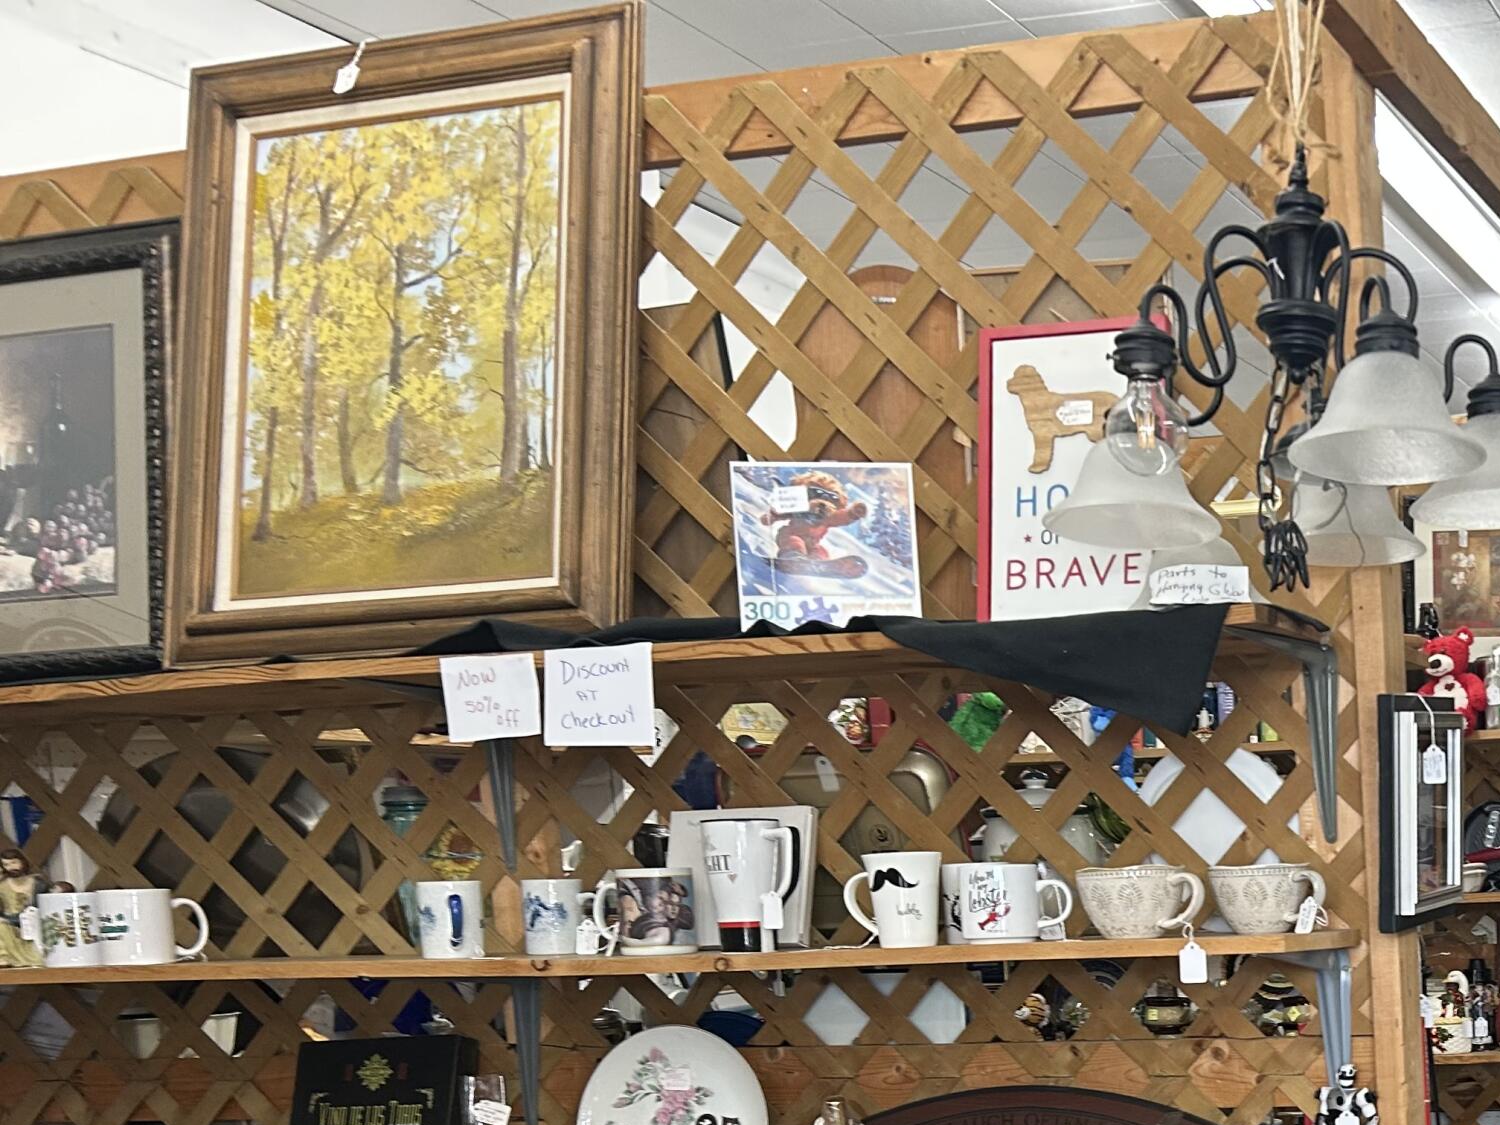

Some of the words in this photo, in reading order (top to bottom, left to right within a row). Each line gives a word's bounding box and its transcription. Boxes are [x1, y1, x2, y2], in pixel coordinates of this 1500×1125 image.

[1016, 484, 1069, 517] HO
[1006, 553, 1142, 591] BRAVE
[744, 602, 790, 620] 300
